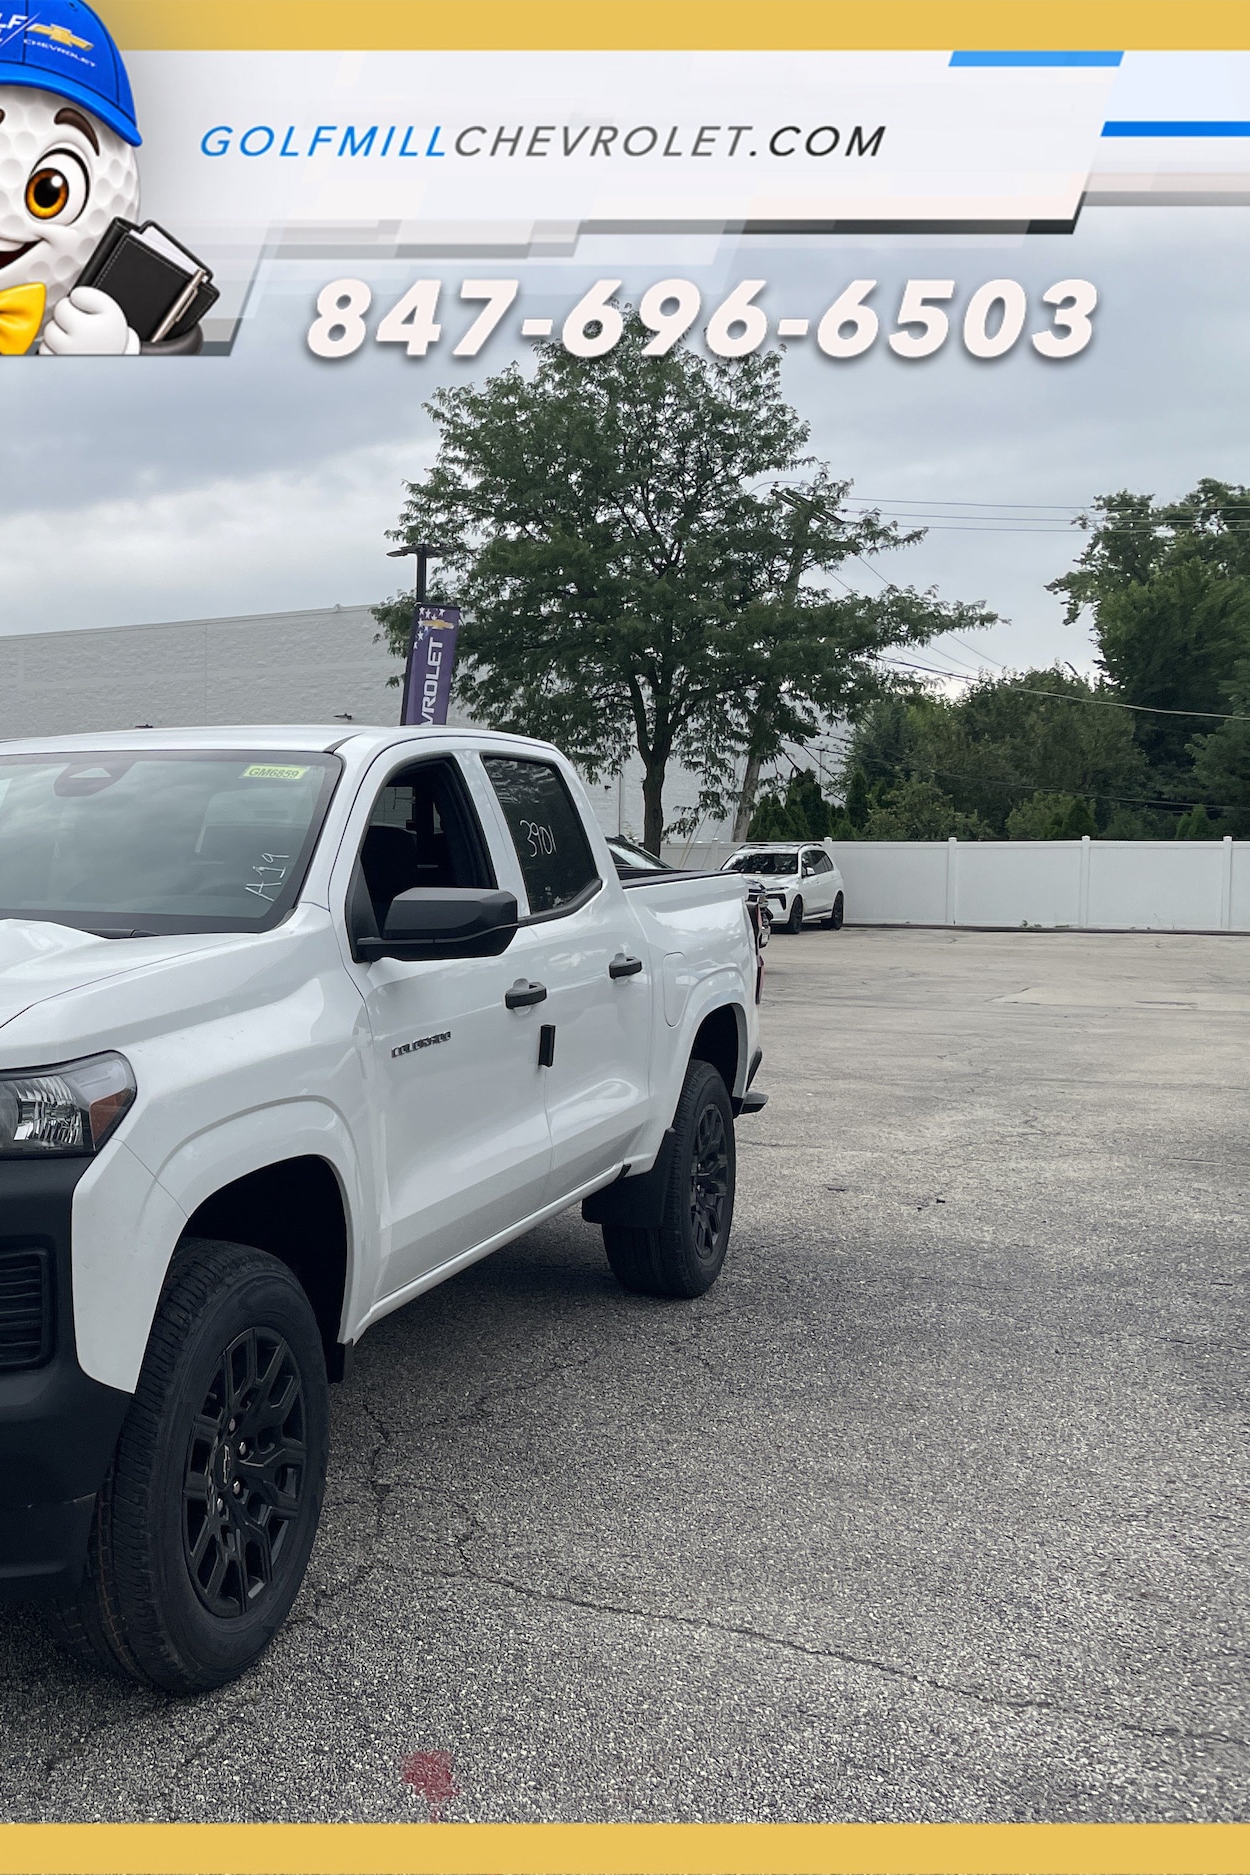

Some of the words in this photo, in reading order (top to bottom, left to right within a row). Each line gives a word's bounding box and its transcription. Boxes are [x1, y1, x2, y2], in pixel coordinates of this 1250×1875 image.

[420, 636, 443, 726] VROLET
[249, 767, 300, 779] GM6859
[391, 1031, 452, 1058] COLORADO
